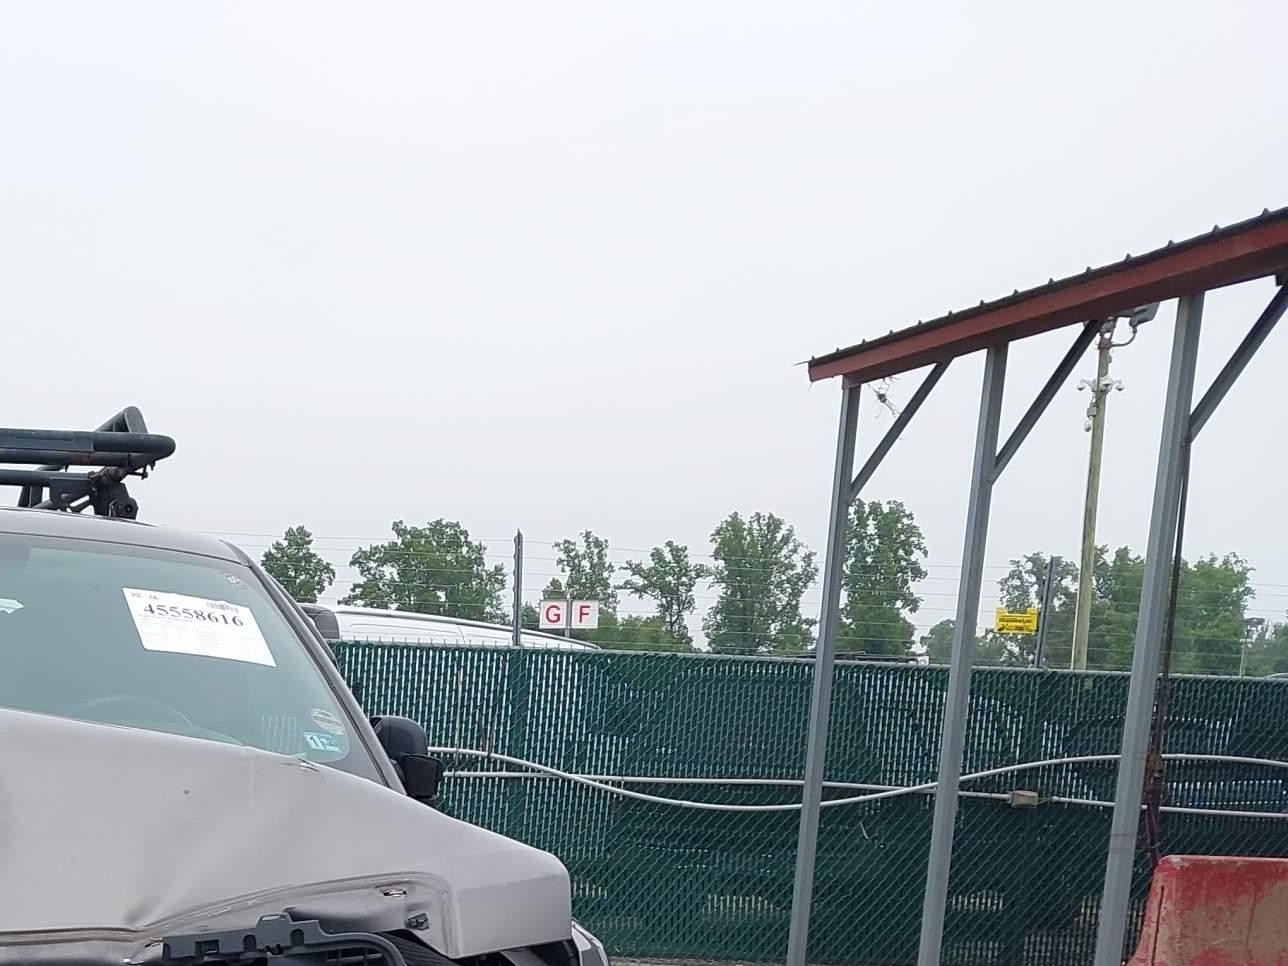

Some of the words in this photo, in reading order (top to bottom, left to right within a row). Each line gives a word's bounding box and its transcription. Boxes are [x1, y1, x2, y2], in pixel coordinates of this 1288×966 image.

[143, 603, 245, 627] 45558616
[545, 604, 561, 624] G
[578, 604, 591, 624] F
